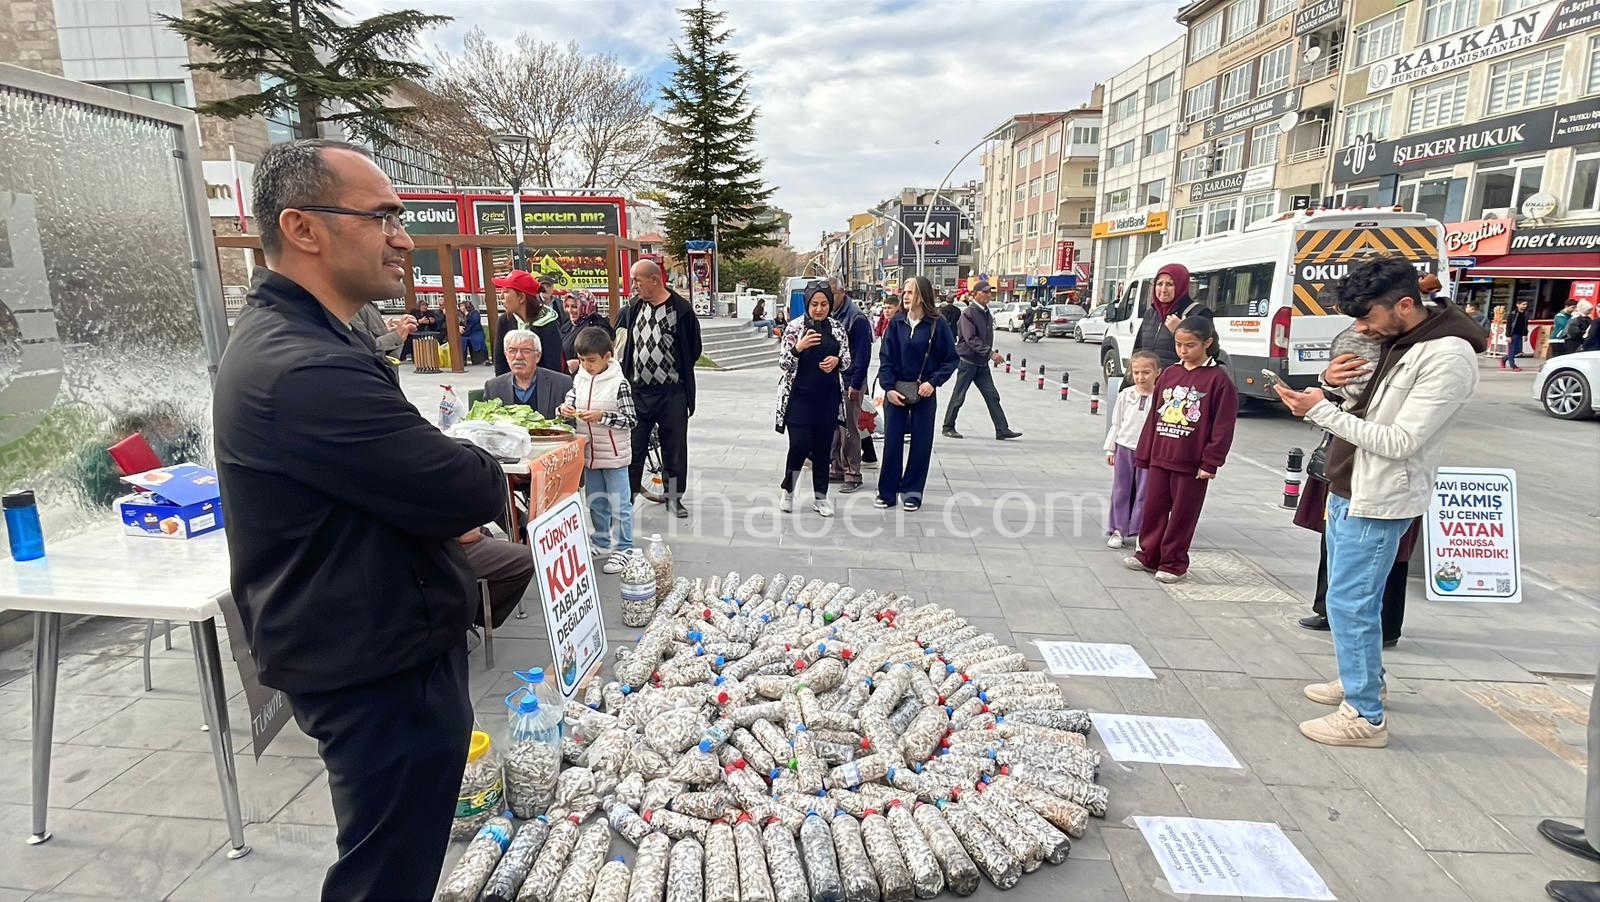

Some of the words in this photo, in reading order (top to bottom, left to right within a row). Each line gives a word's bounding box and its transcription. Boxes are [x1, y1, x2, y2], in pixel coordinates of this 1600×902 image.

[1392, 11, 1541, 76] KALKAN
[1390, 69, 1428, 84] HUKUK
[1431, 63, 1440, 73] &
[1393, 138, 1457, 166] İŞLEKER
[1458, 124, 1526, 152] HUKUK
[1204, 174, 1243, 192] KARADAĞ
[417, 208, 456, 223] GÜNÜ
[913, 221, 950, 238] ZEN
[1511, 232, 1556, 248] mert
[1460, 482, 1509, 492] BONCUK
[1438, 493, 1503, 510] TAKMIŞ
[1439, 510, 1454, 521] ŞU
[1457, 511, 1503, 521] CENNET
[539, 513, 579, 555] TÜRKİYE
[1440, 521, 1504, 538] VATAN
[1436, 547, 1509, 559] UTANIRDIK!
[545, 542, 587, 601] KÜL
[552, 575, 590, 623] TABLASI
